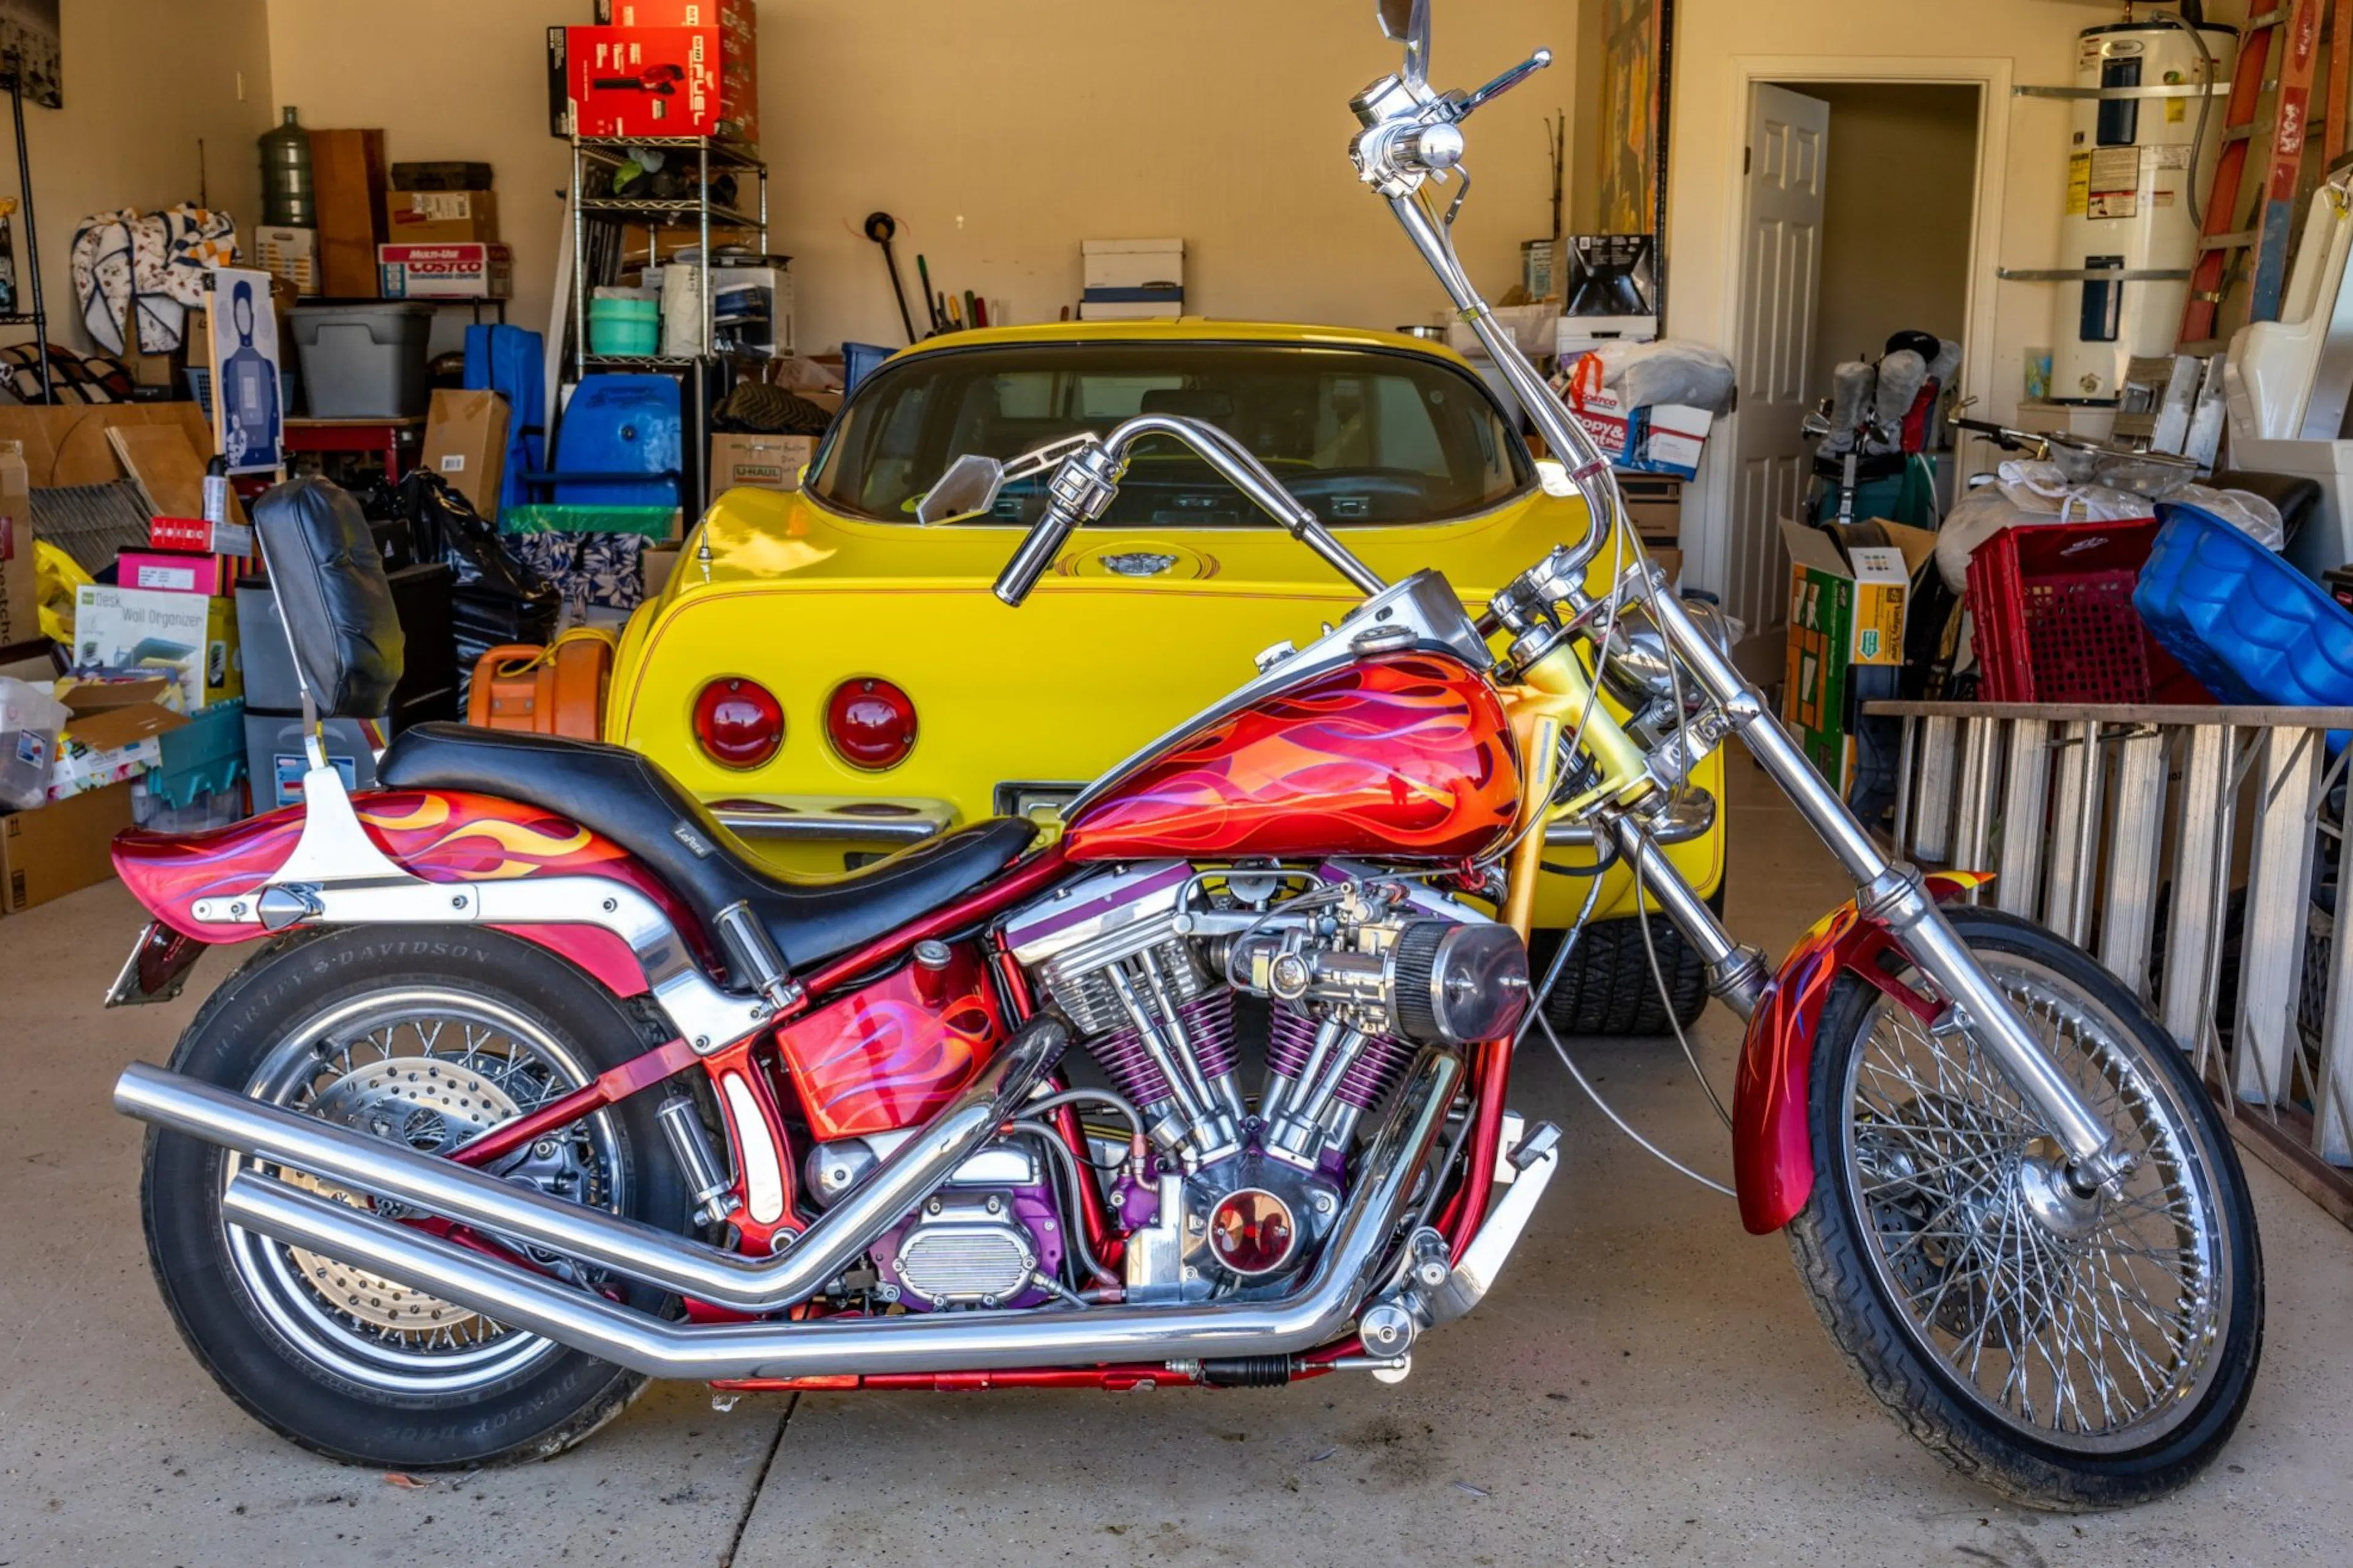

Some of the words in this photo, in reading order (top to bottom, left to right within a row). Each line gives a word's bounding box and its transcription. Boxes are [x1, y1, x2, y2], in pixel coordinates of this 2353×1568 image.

[693, 63, 705, 126] FUEL
[409, 262, 482, 273] COSTCO
[1611, 425, 1624, 439] &
[736, 466, 780, 477] U-HAUL
[96, 591, 121, 608] Desk
[123, 607, 145, 623] Wall
[148, 610, 202, 628] Organizer
[338, 941, 490, 966] DAVIDSON
